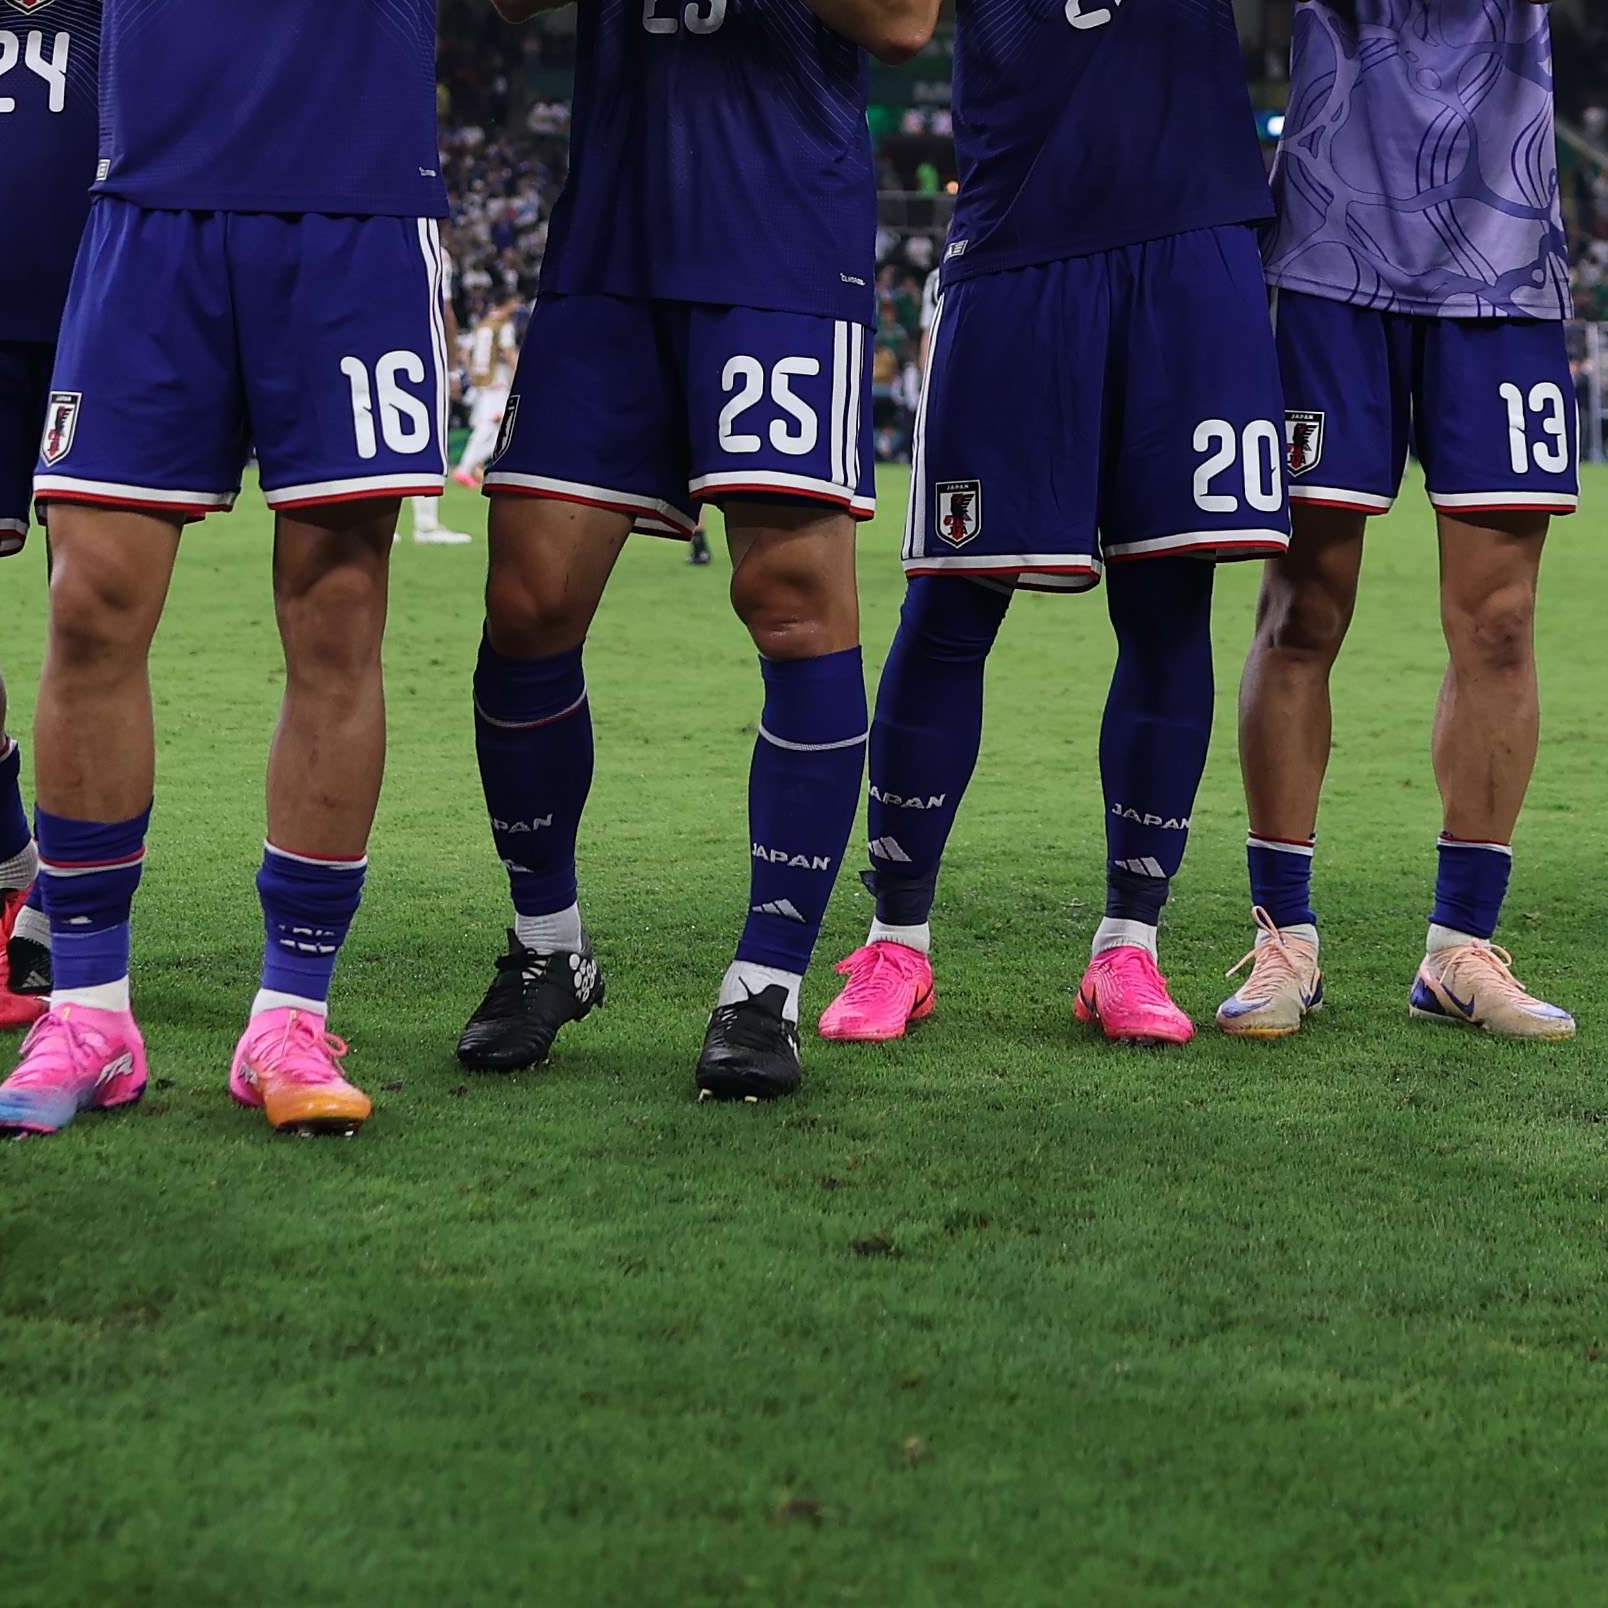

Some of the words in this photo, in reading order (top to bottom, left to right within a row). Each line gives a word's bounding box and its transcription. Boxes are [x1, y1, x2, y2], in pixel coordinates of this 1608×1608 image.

[340, 349, 430, 459] 16
[719, 355, 819, 455] 25
[1499, 382, 1569, 474] 13
[1192, 419, 1282, 513] 20
[493, 814, 552, 833] PAN
[753, 843, 831, 870] JAPAN
[1112, 803, 1190, 830] JAPAN
